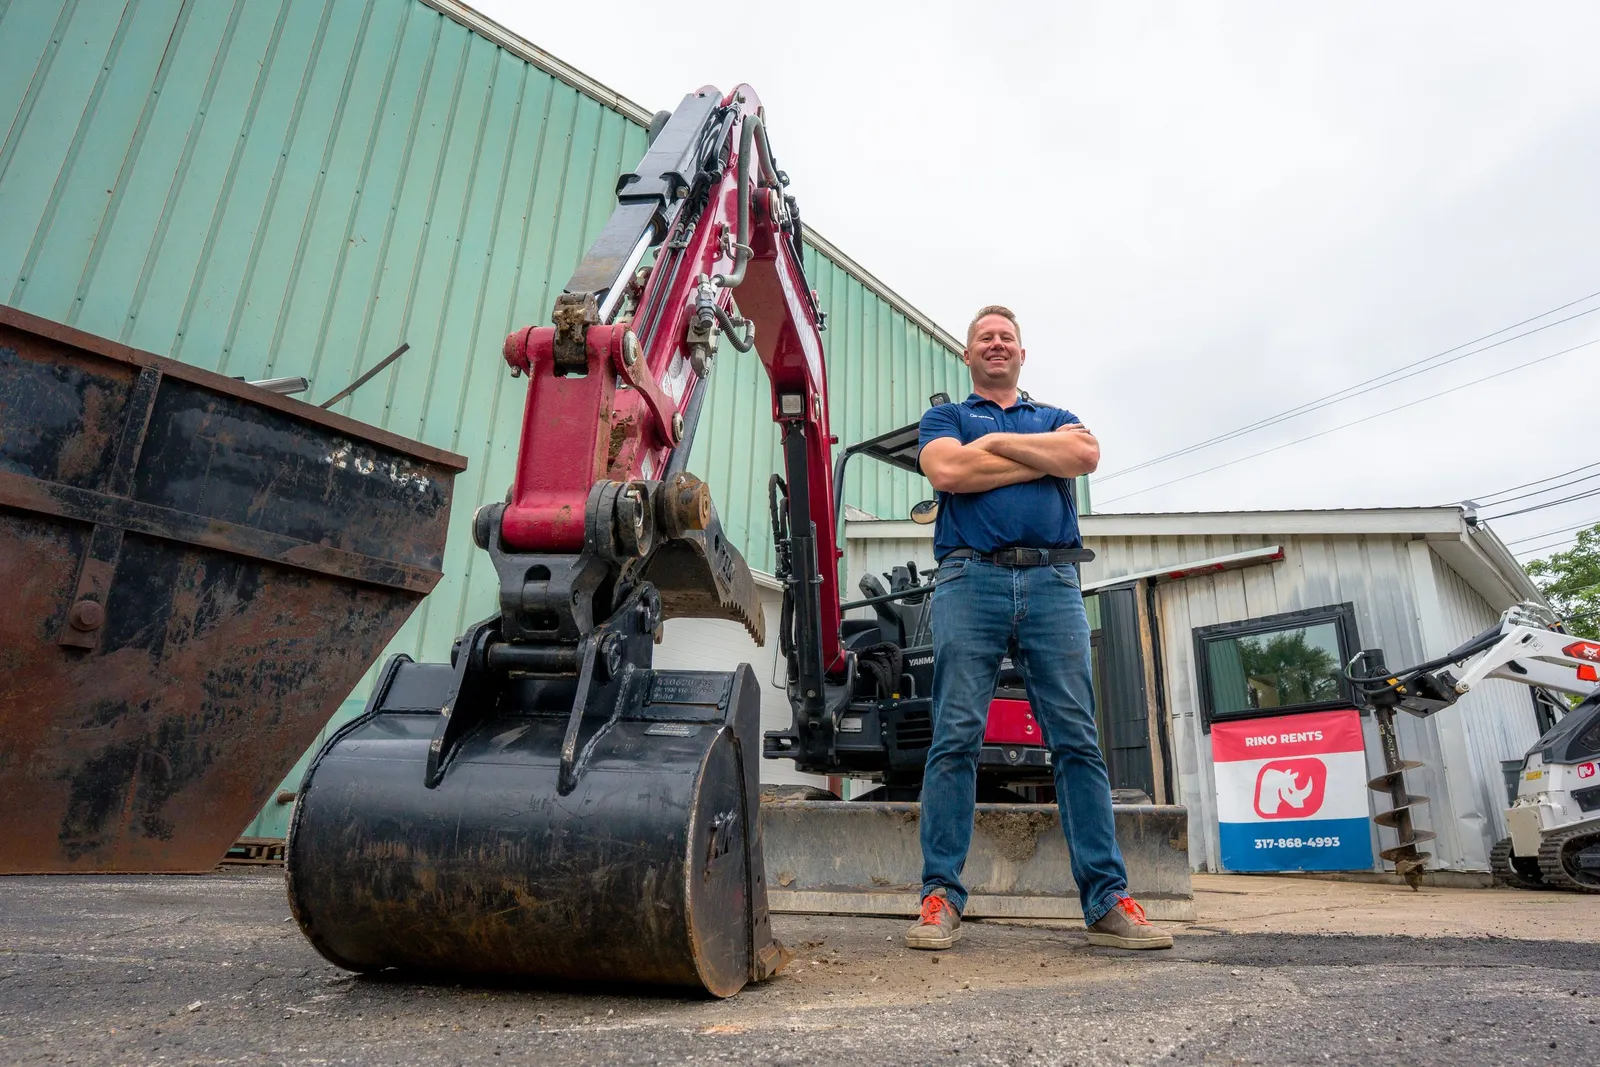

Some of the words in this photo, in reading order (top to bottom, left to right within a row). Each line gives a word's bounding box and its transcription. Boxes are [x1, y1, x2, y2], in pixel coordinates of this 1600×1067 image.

[1245, 735, 1277, 747] RINO
[1280, 730, 1323, 744] RENTS
[1254, 837, 1341, 849] 317-868-4993
